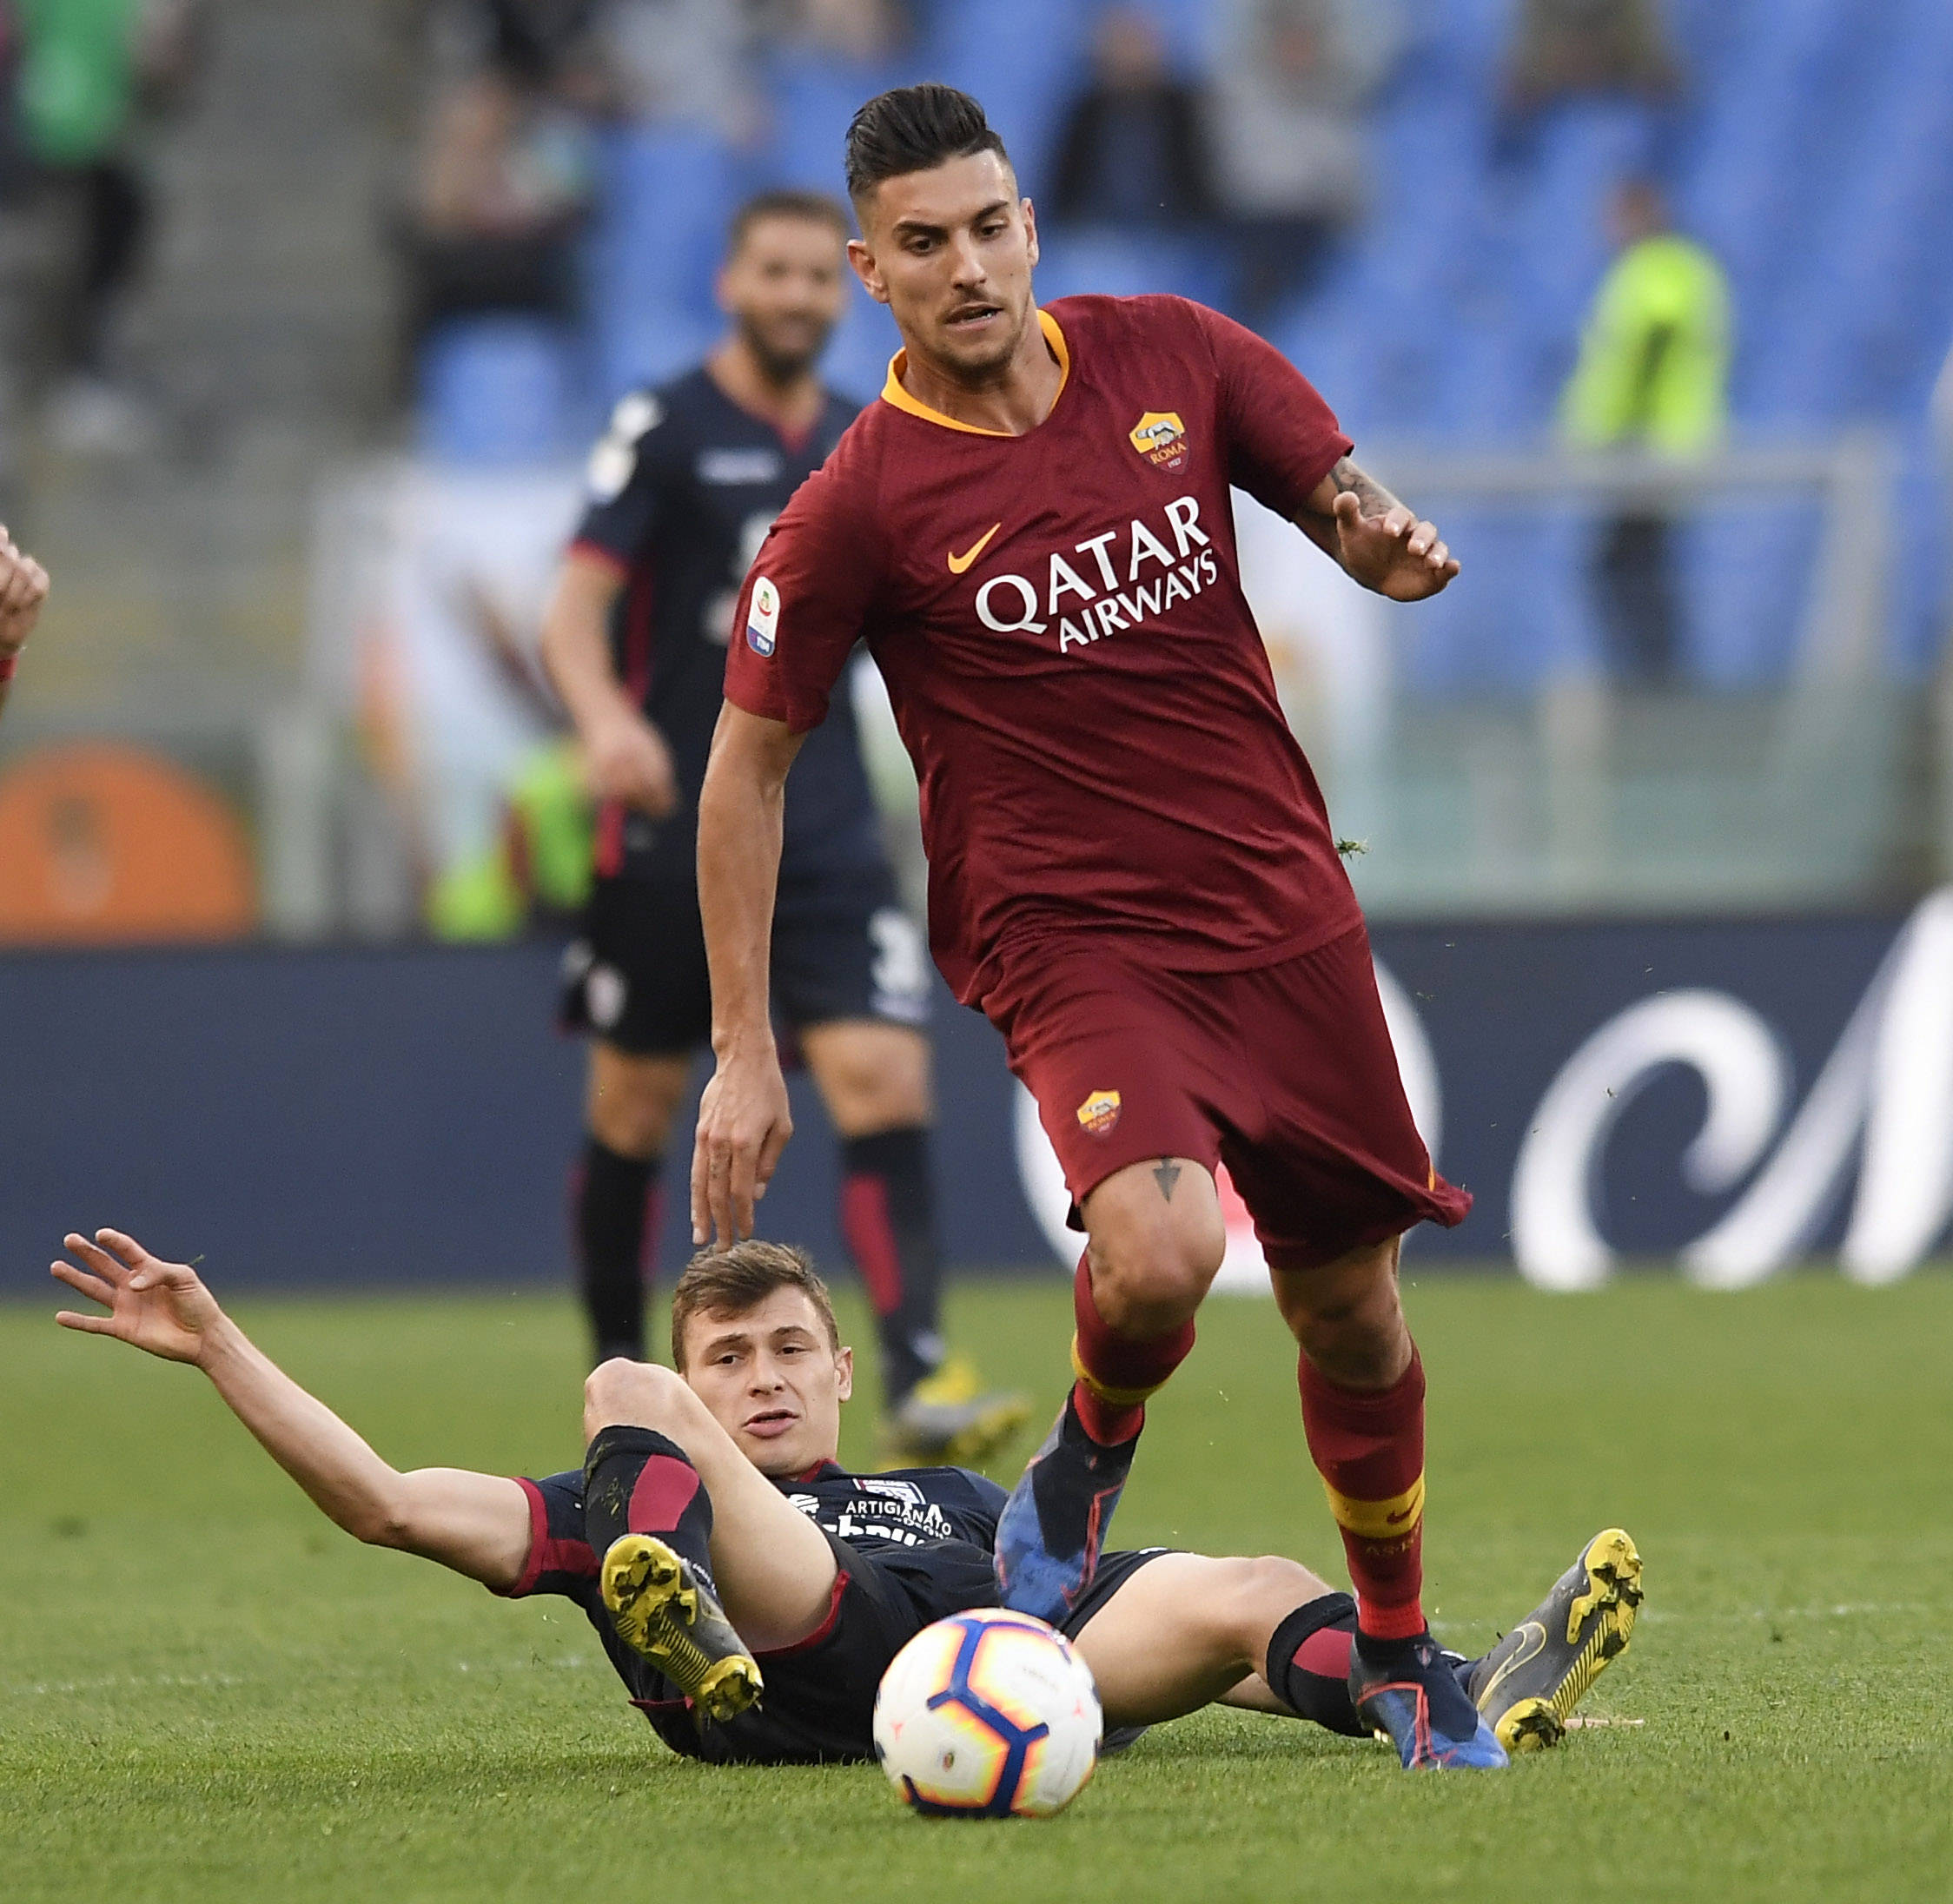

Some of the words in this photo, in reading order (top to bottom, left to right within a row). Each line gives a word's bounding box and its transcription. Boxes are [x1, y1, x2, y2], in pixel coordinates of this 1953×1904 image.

[1149, 441, 1188, 465] ROMA
[975, 496, 1211, 635] QATAR
[1058, 548, 1218, 654] AIRWAYS
[845, 1500, 952, 1537] ARTIGIANATO
